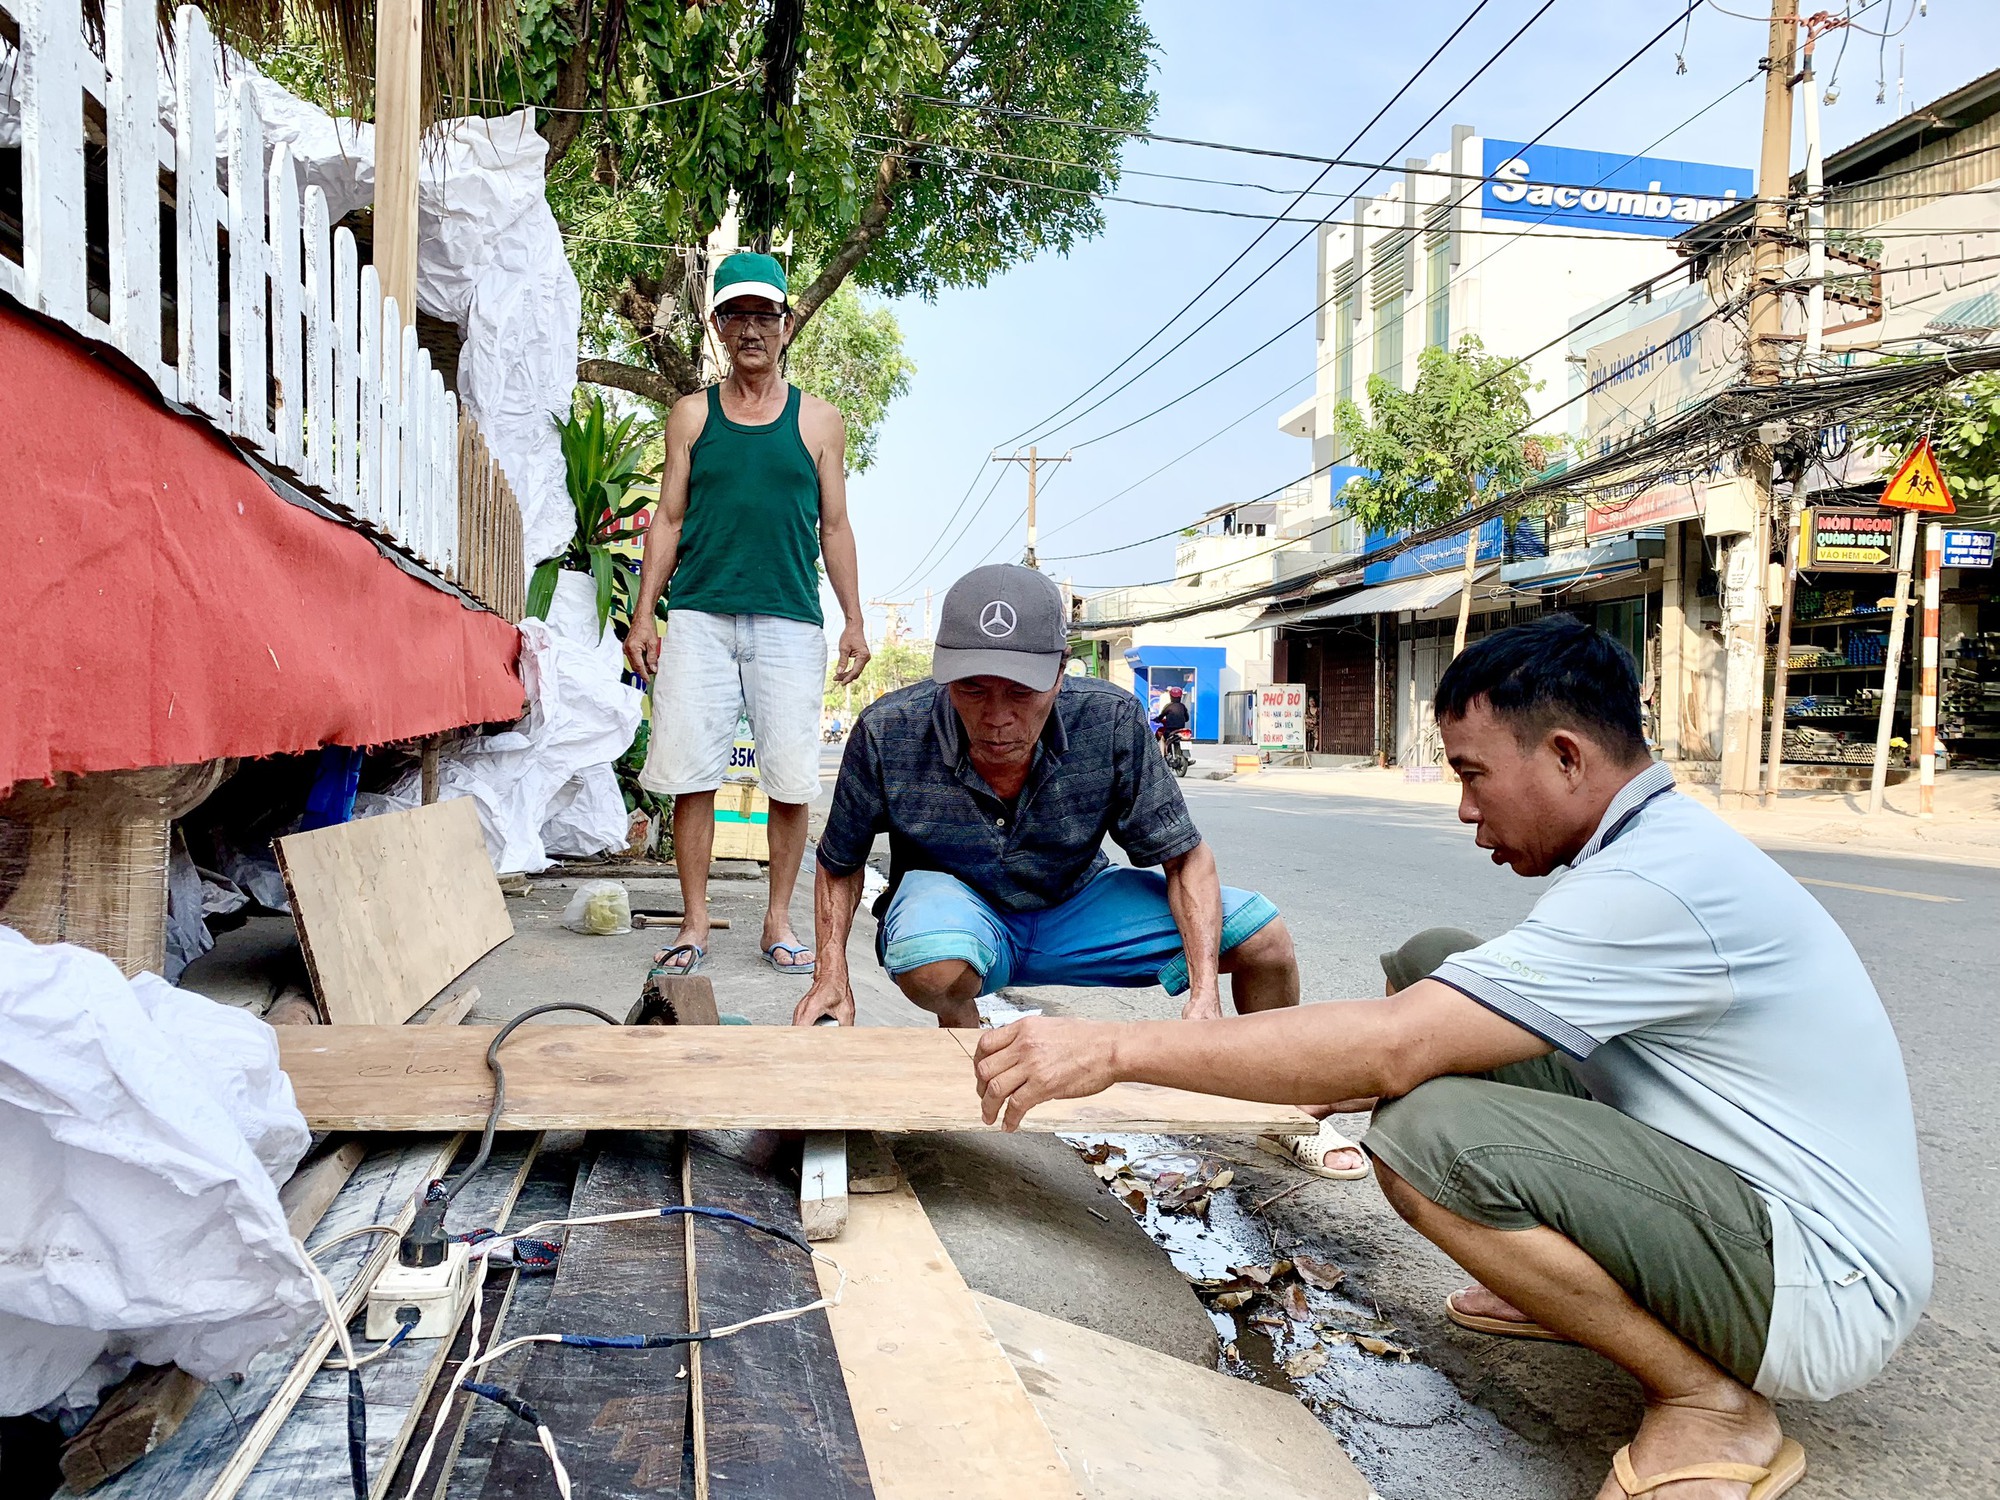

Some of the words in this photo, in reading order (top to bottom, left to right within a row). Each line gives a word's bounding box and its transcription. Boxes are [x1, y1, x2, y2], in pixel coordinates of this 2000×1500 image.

[1610, 353, 1635, 387] HÀNG
[1637, 336, 1656, 377] SẮT
[1818, 515, 1851, 531] MÓN
[1853, 518, 1892, 532] NGON
[1817, 531, 1856, 547] QUẢNG
[1857, 532, 1885, 547] NGÃI
[1820, 550, 1840, 559] VÀO
[1863, 552, 1880, 560] 40M
[1262, 688, 1285, 706] PHỞ
[1287, 689, 1301, 706] BÒ
[1272, 734, 1284, 743] KHO
